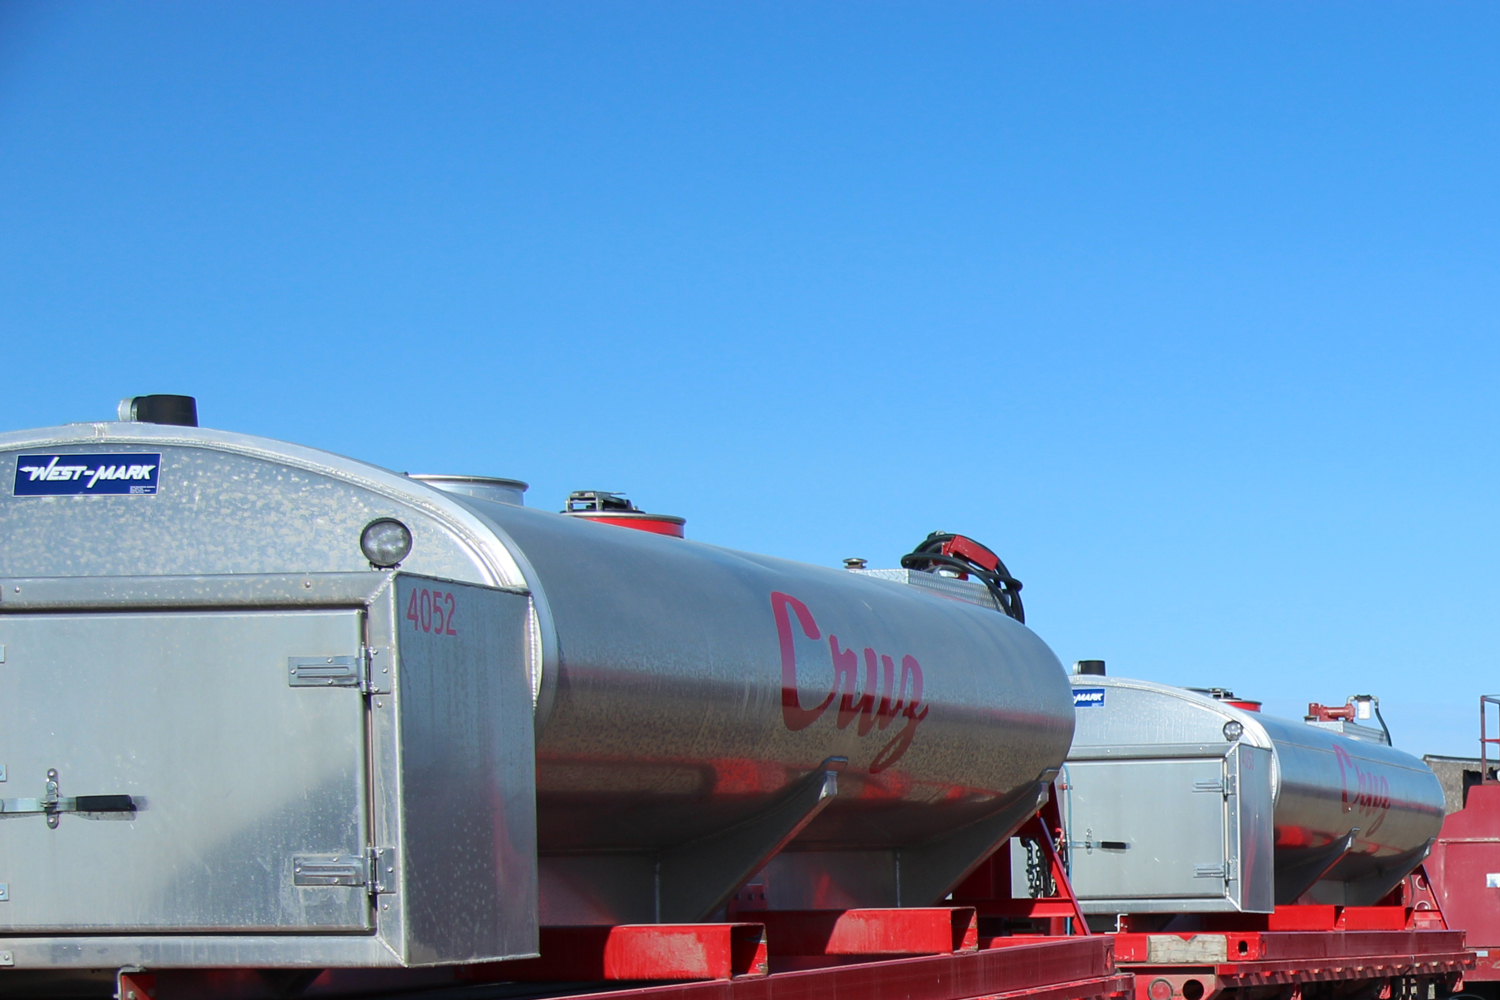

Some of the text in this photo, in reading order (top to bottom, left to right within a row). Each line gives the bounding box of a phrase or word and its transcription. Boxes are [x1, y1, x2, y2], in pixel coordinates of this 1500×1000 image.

[19, 456, 156, 488] WEST-MARK
[407, 588, 457, 636] 4052
[770, 591, 929, 774] Cruz
[1332, 743, 1391, 837] Cruz
